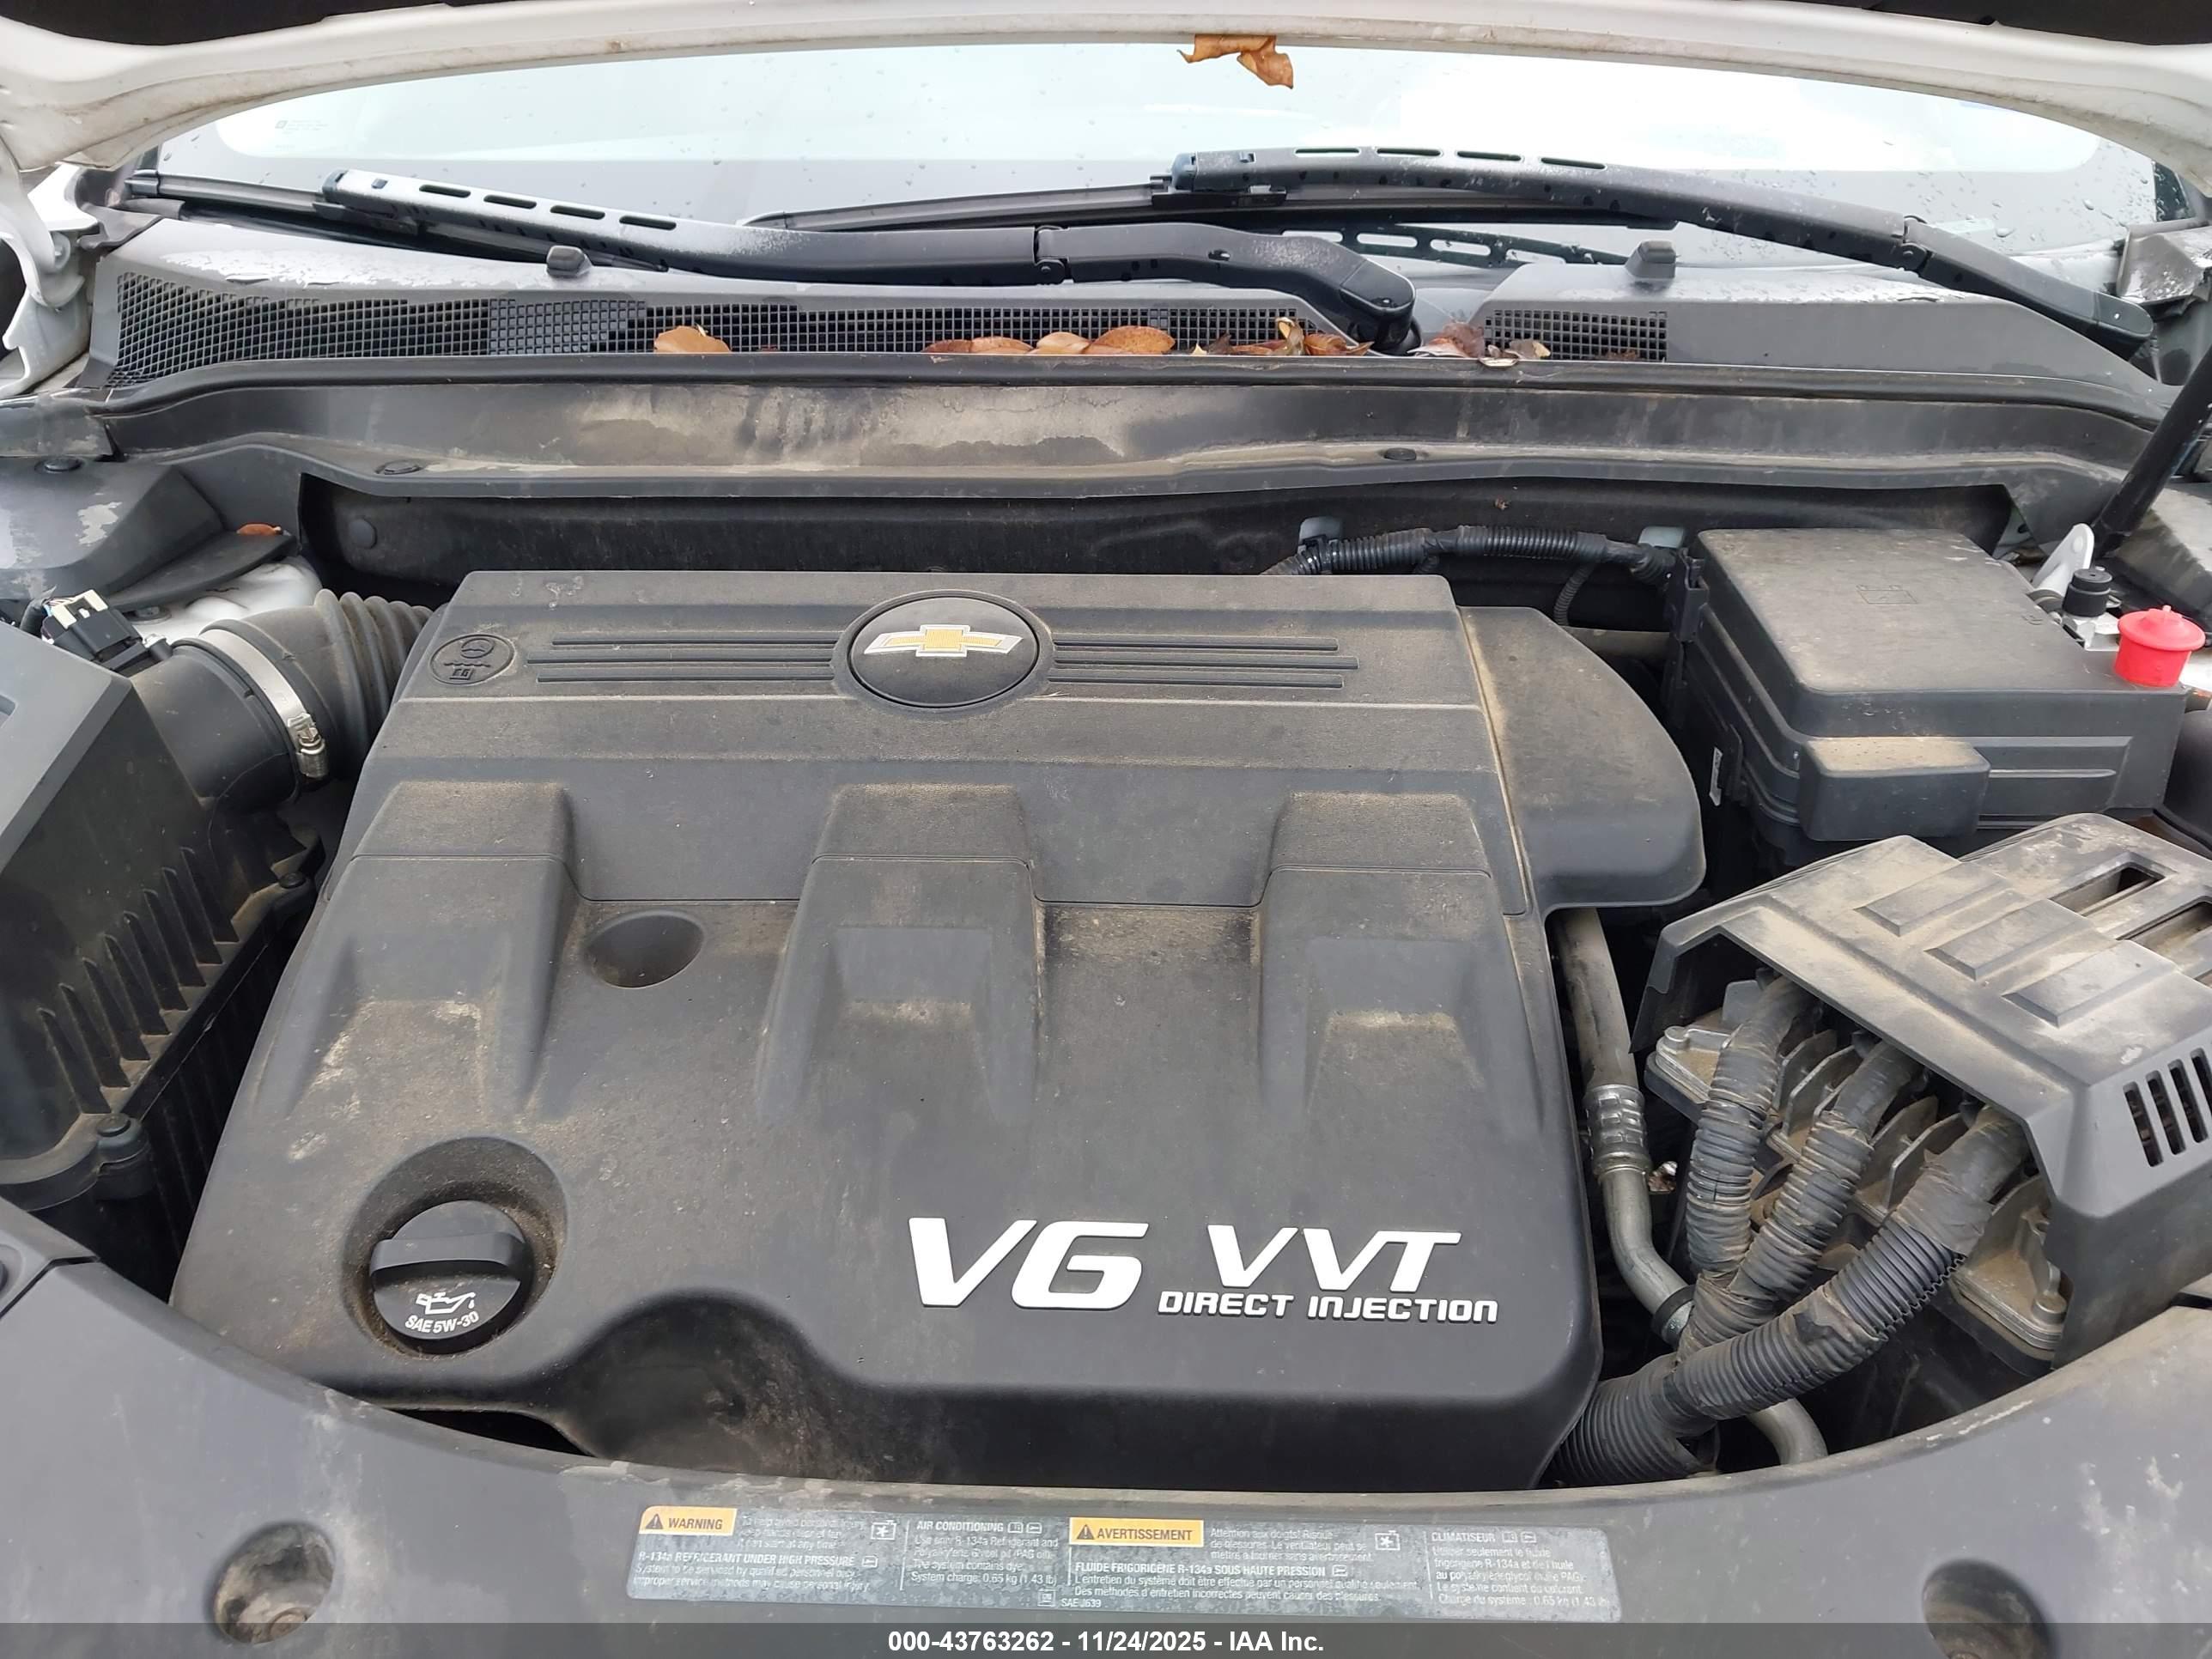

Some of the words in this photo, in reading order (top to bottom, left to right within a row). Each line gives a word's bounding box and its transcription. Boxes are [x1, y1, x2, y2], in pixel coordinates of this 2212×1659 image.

[908, 1217, 1149, 1310] V6
[1207, 1224, 1462, 1292] VVT
[1158, 1291, 1294, 1319] DIRECT
[1308, 1295, 1499, 1324] INJECTION
[404, 1315, 434, 1334] SAE
[432, 1310, 480, 1334] 5W-30
[668, 1517, 723, 1530] WARNING
[917, 1521, 933, 1531] AIR
[935, 1522, 1004, 1532] CONDITIONING
[1097, 1528, 1193, 1540] AVERTISSEMENT
[1431, 1531, 1496, 1543] CLIMATISEUR
[1042, 1538, 1059, 1547] and
[743, 1553, 776, 1565] UNDER
[778, 1554, 803, 1565] HIGH
[805, 1555, 855, 1566] PRESSURE
[966, 1562, 1005, 1571] contains
[1075, 1562, 1109, 1572] FLUIDE
[1177, 1564, 1212, 1575] R-134a
[1214, 1565, 1242, 1576] SOUS
[1243, 1565, 1274, 1576] HAUTE
[1276, 1565, 1326, 1577] PRESSION
[911, 1571, 945, 1583] System
[982, 1573, 1005, 1583] 0.65
[1006, 1574, 1018, 1586] kg
[1045, 1574, 1058, 1587] lb)
[1124, 1575, 1137, 1584] du
[1178, 1576, 1195, 1586] doit
[1196, 1576, 1216, 1587] être
[1436, 1571, 1448, 1580] au
[1075, 1586, 1093, 1596] Des
[1193, 1589, 1243, 1600] incorrectes
[1060, 1597, 1079, 1607] SAE
